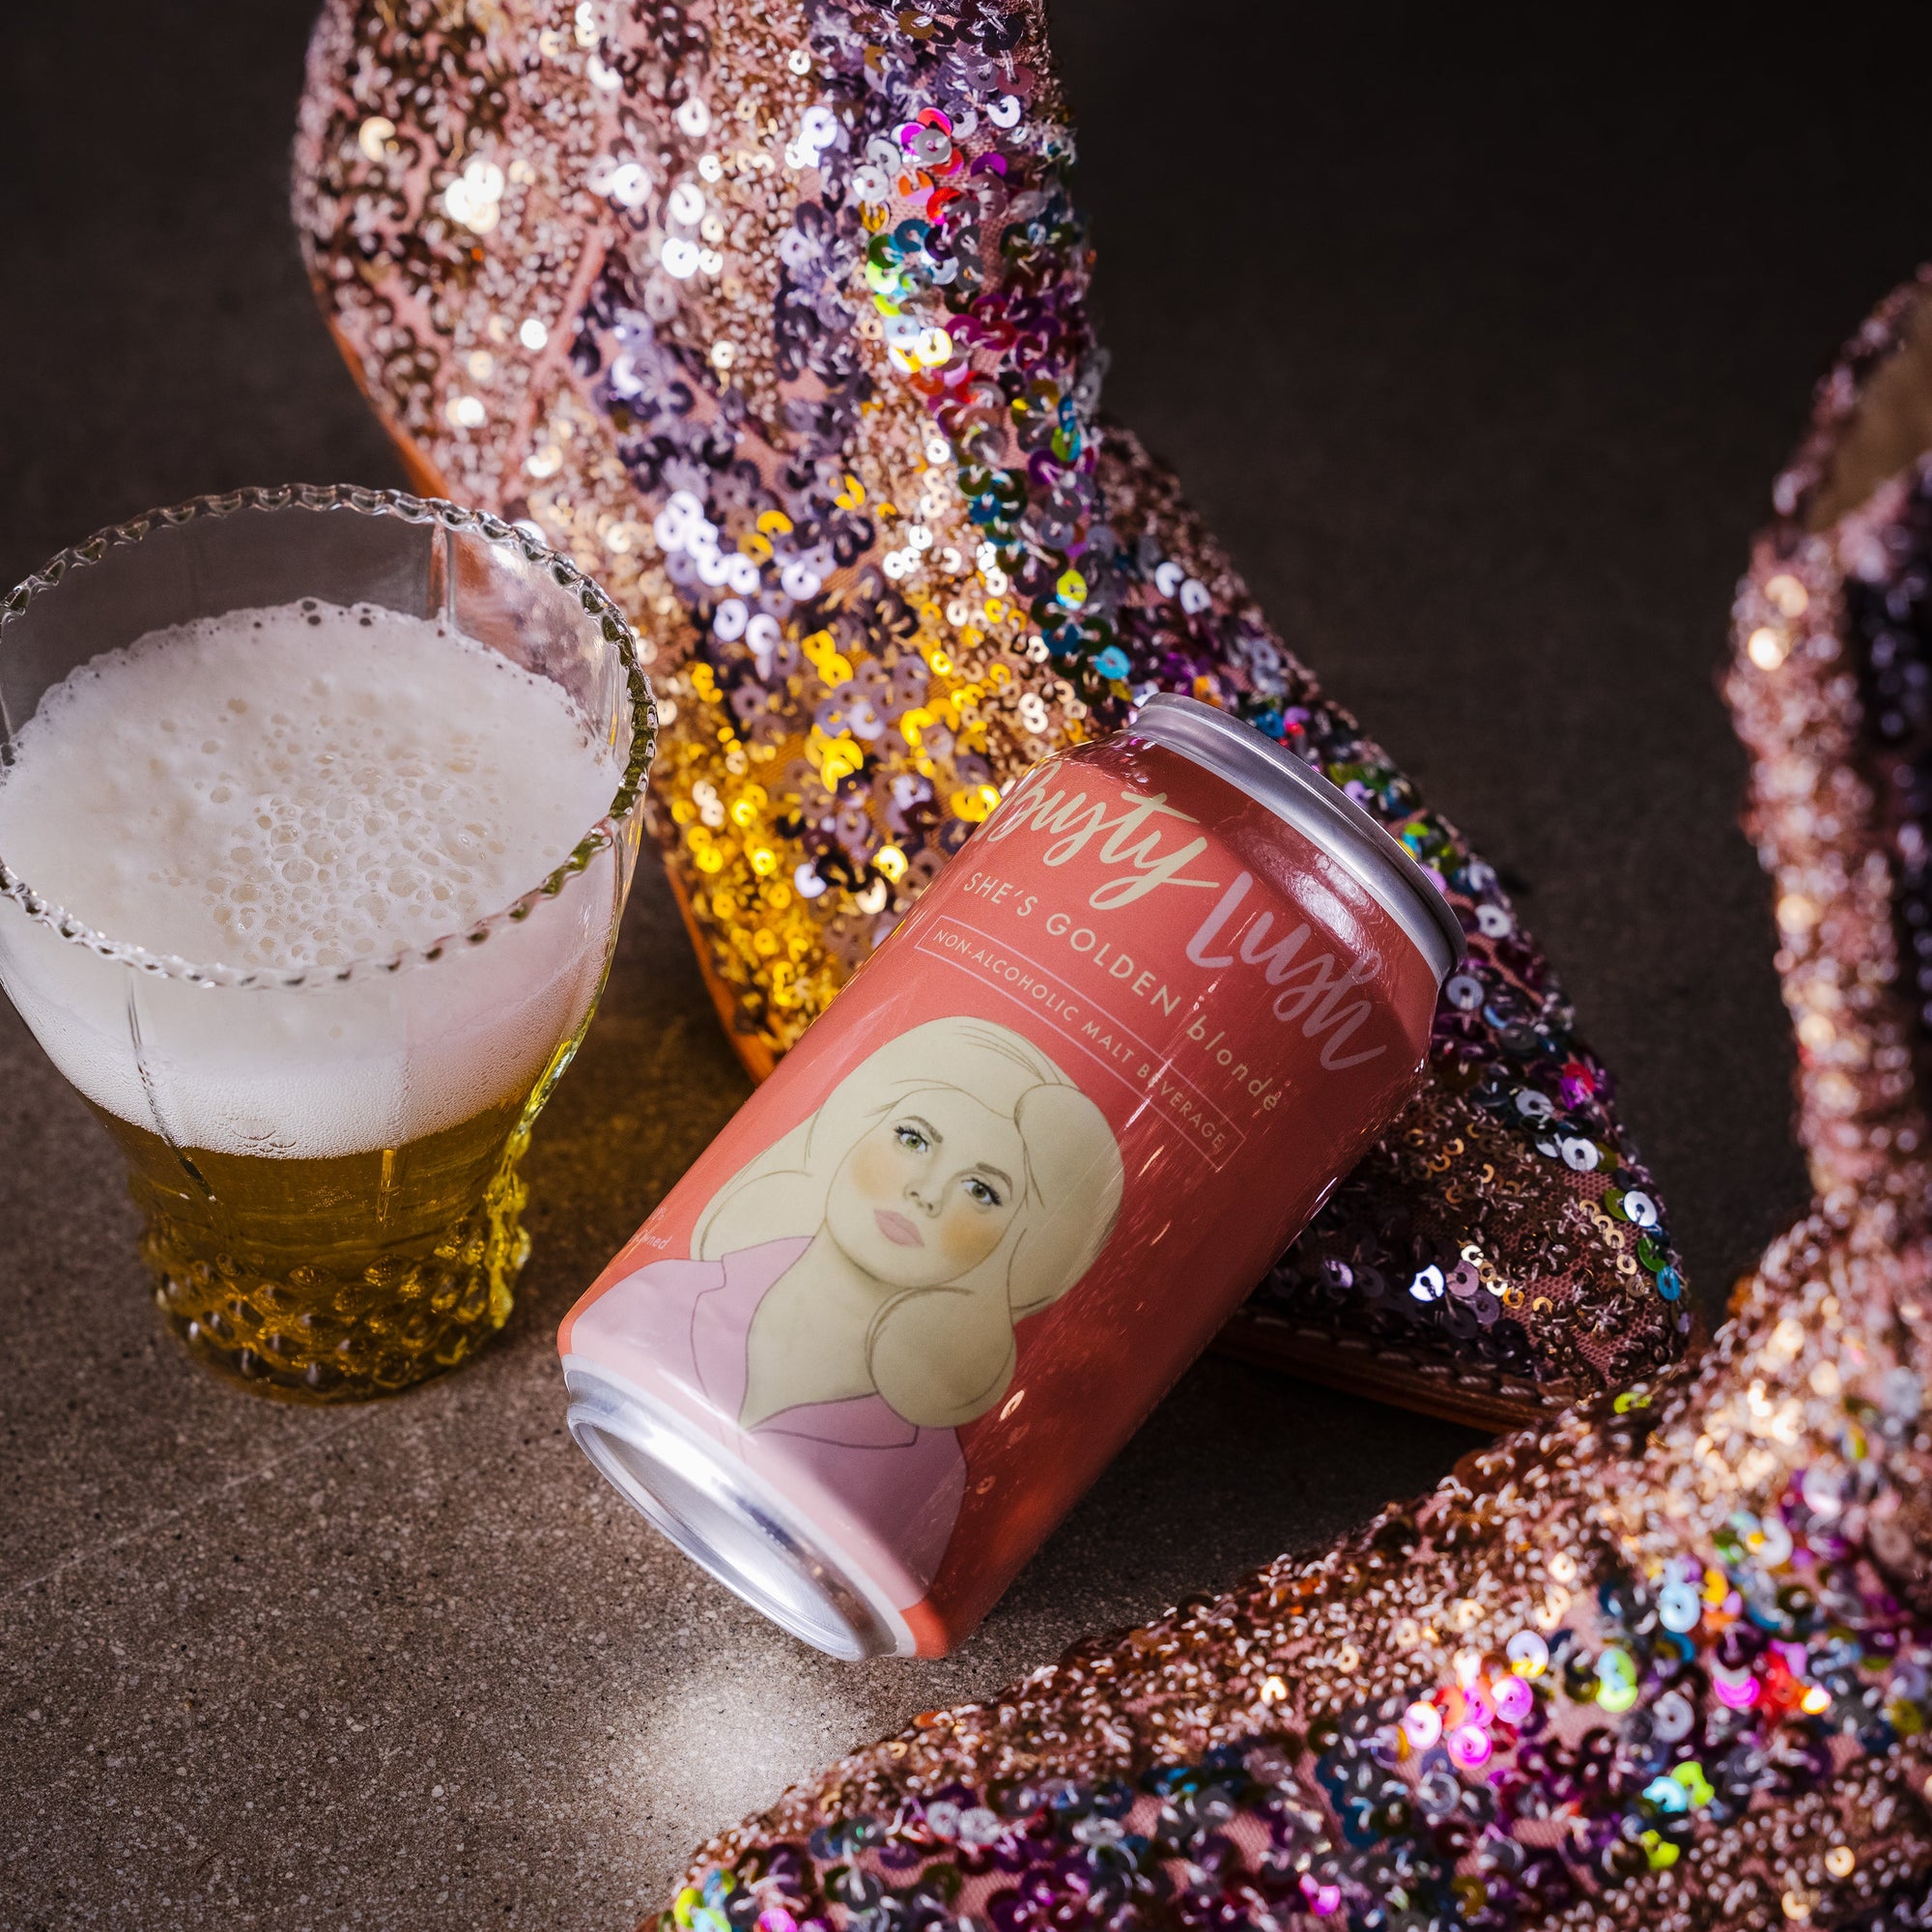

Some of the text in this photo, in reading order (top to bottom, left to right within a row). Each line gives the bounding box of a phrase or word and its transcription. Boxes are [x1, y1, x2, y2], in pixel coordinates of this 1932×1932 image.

[963, 871, 1038, 918] SHE'S
[1047, 912, 1180, 1018] GOLDEN
[974, 761, 1386, 1071] Busty Lush
[932, 928, 1079, 1024] NON-ALCOHOLIC
[1082, 1021, 1135, 1065] MALT
